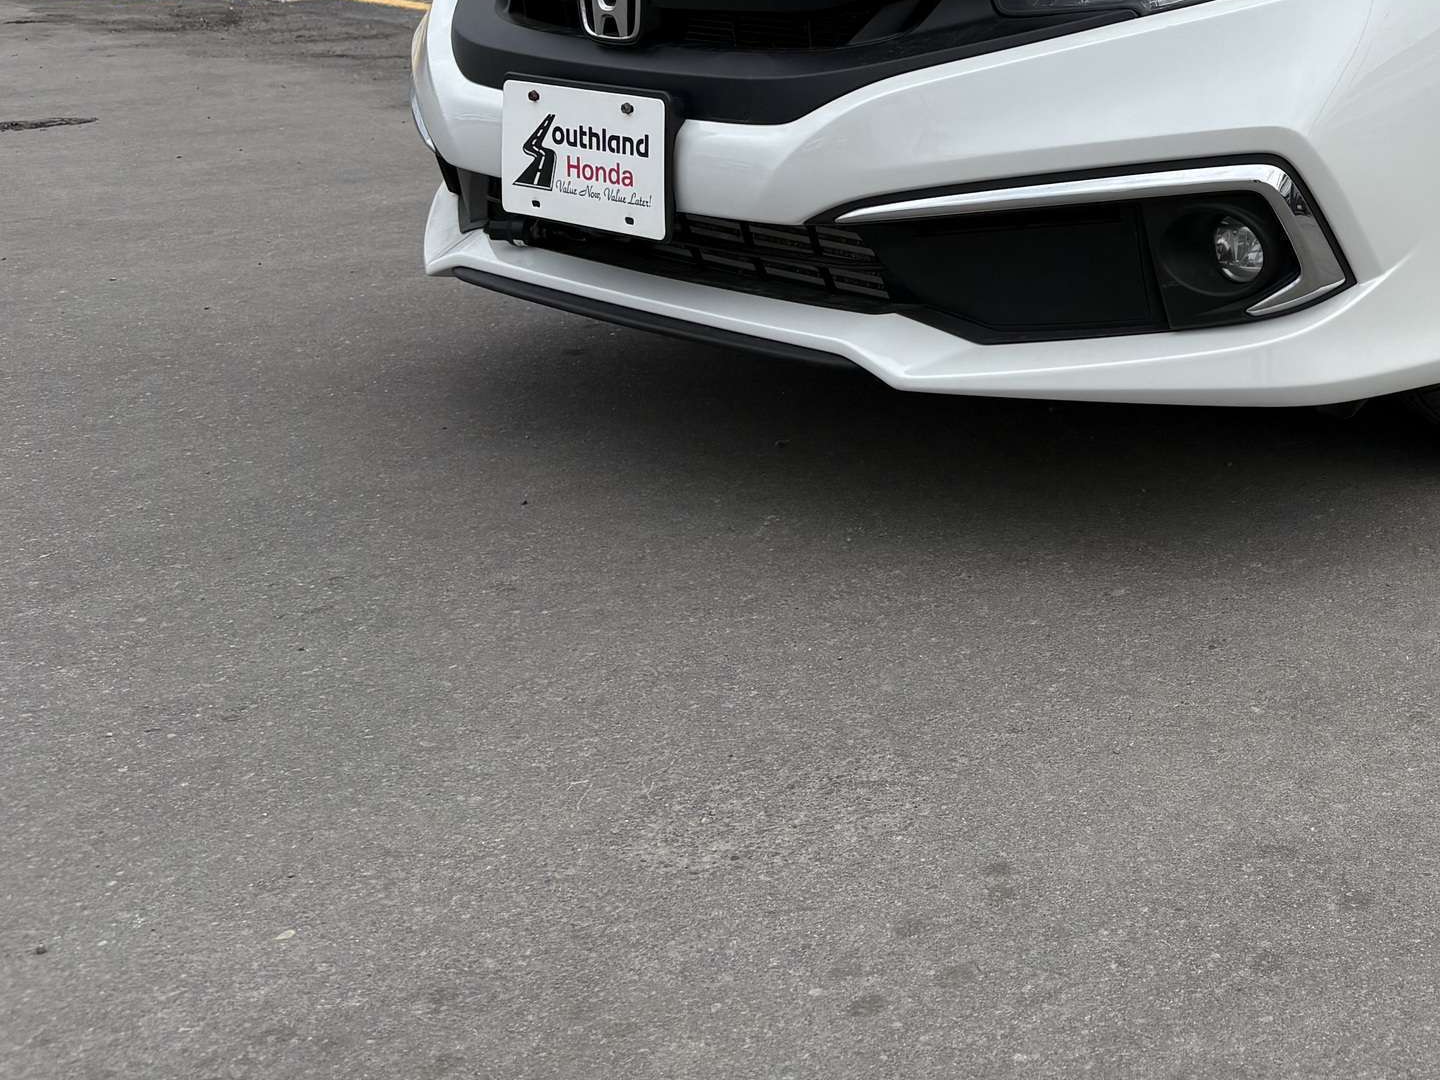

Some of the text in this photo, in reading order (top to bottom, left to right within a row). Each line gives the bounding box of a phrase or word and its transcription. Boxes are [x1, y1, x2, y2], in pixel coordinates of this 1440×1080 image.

[566, 155, 634, 187] Honda
[556, 180, 652, 207] Value Now, Value Later!
